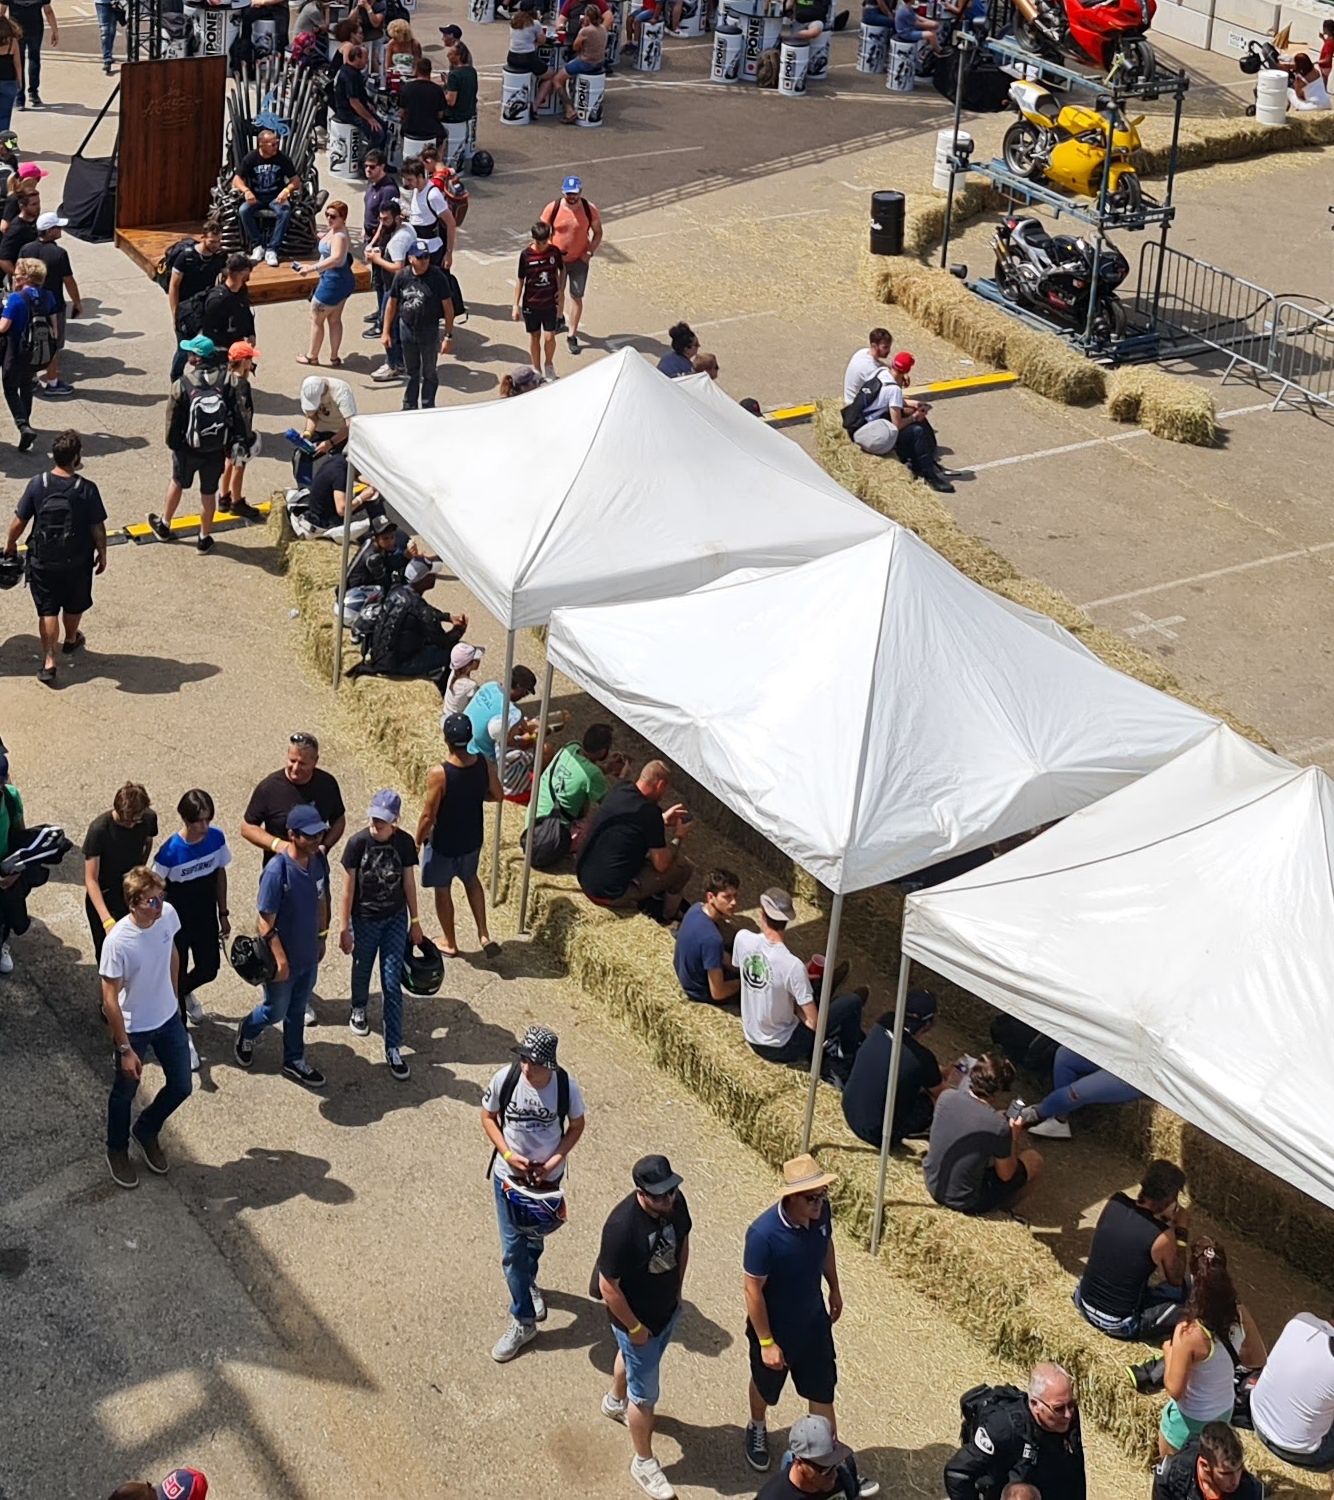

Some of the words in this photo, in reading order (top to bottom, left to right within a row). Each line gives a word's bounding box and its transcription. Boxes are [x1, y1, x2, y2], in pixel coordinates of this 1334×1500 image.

[715, 39, 725, 68] IPONE
[746, 18, 760, 62] IPONE
[784, 52, 794, 81] IPONE
[578, 80, 589, 112] IPONE
[351, 130, 359, 163] IPONE
